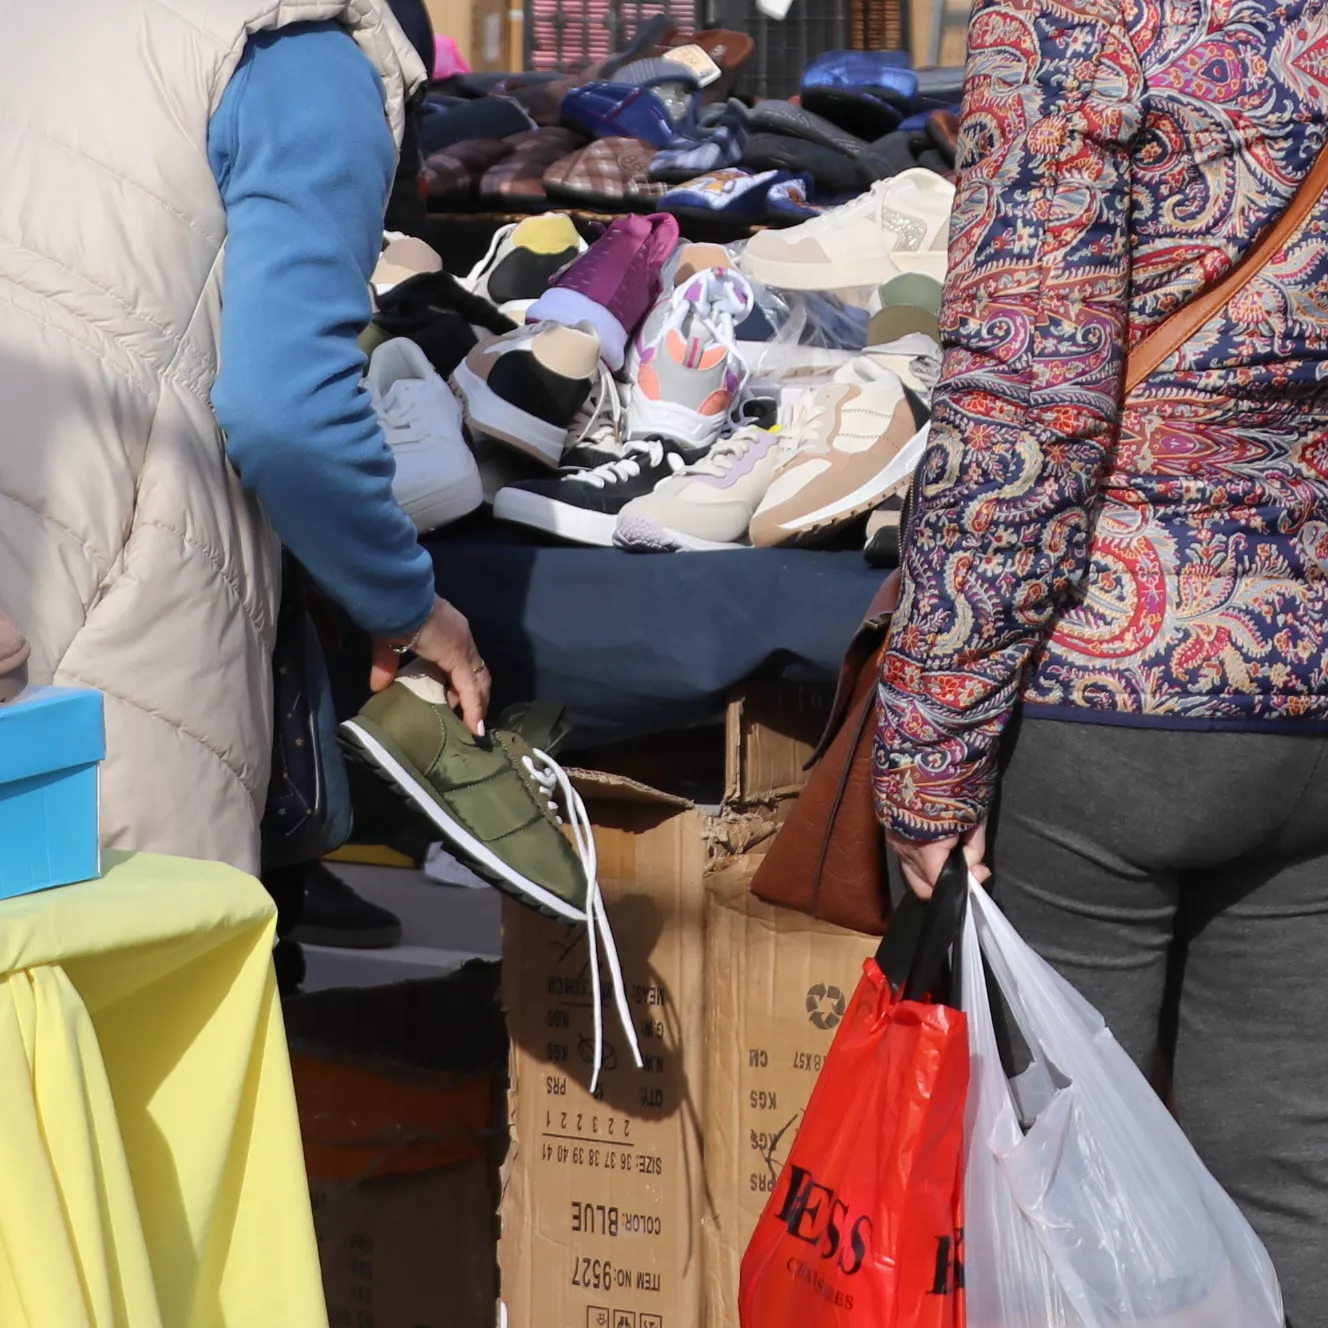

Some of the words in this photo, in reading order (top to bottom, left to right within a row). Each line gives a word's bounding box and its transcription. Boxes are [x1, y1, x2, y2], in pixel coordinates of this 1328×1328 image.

[749, 1049, 768, 1068] CM
[547, 1076, 566, 1095] PRS
[750, 1090, 777, 1109] KGS
[546, 1110, 551, 1127] 1
[560, 1112, 567, 1129] 2
[576, 1114, 583, 1131] 2
[592, 1116, 598, 1133] 3
[608, 1118, 614, 1134] 2
[624, 1119, 630, 1137] 2
[751, 1131, 777, 1151] KGS
[542, 1143, 552, 1161] 41
[557, 1145, 568, 1163] 40
[573, 1147, 584, 1165] 39
[589, 1149, 600, 1167] 38
[604, 1151, 616, 1168] 37
[621, 1153, 632, 1170] 36
[636, 1154, 662, 1175] SIZE:
[750, 1173, 776, 1192] PRS
[572, 1201, 619, 1237] BLUE
[622, 1213, 661, 1235] COLOR:
[572, 1256, 612, 1290] 9527
[637, 1273, 660, 1291] ITEM
